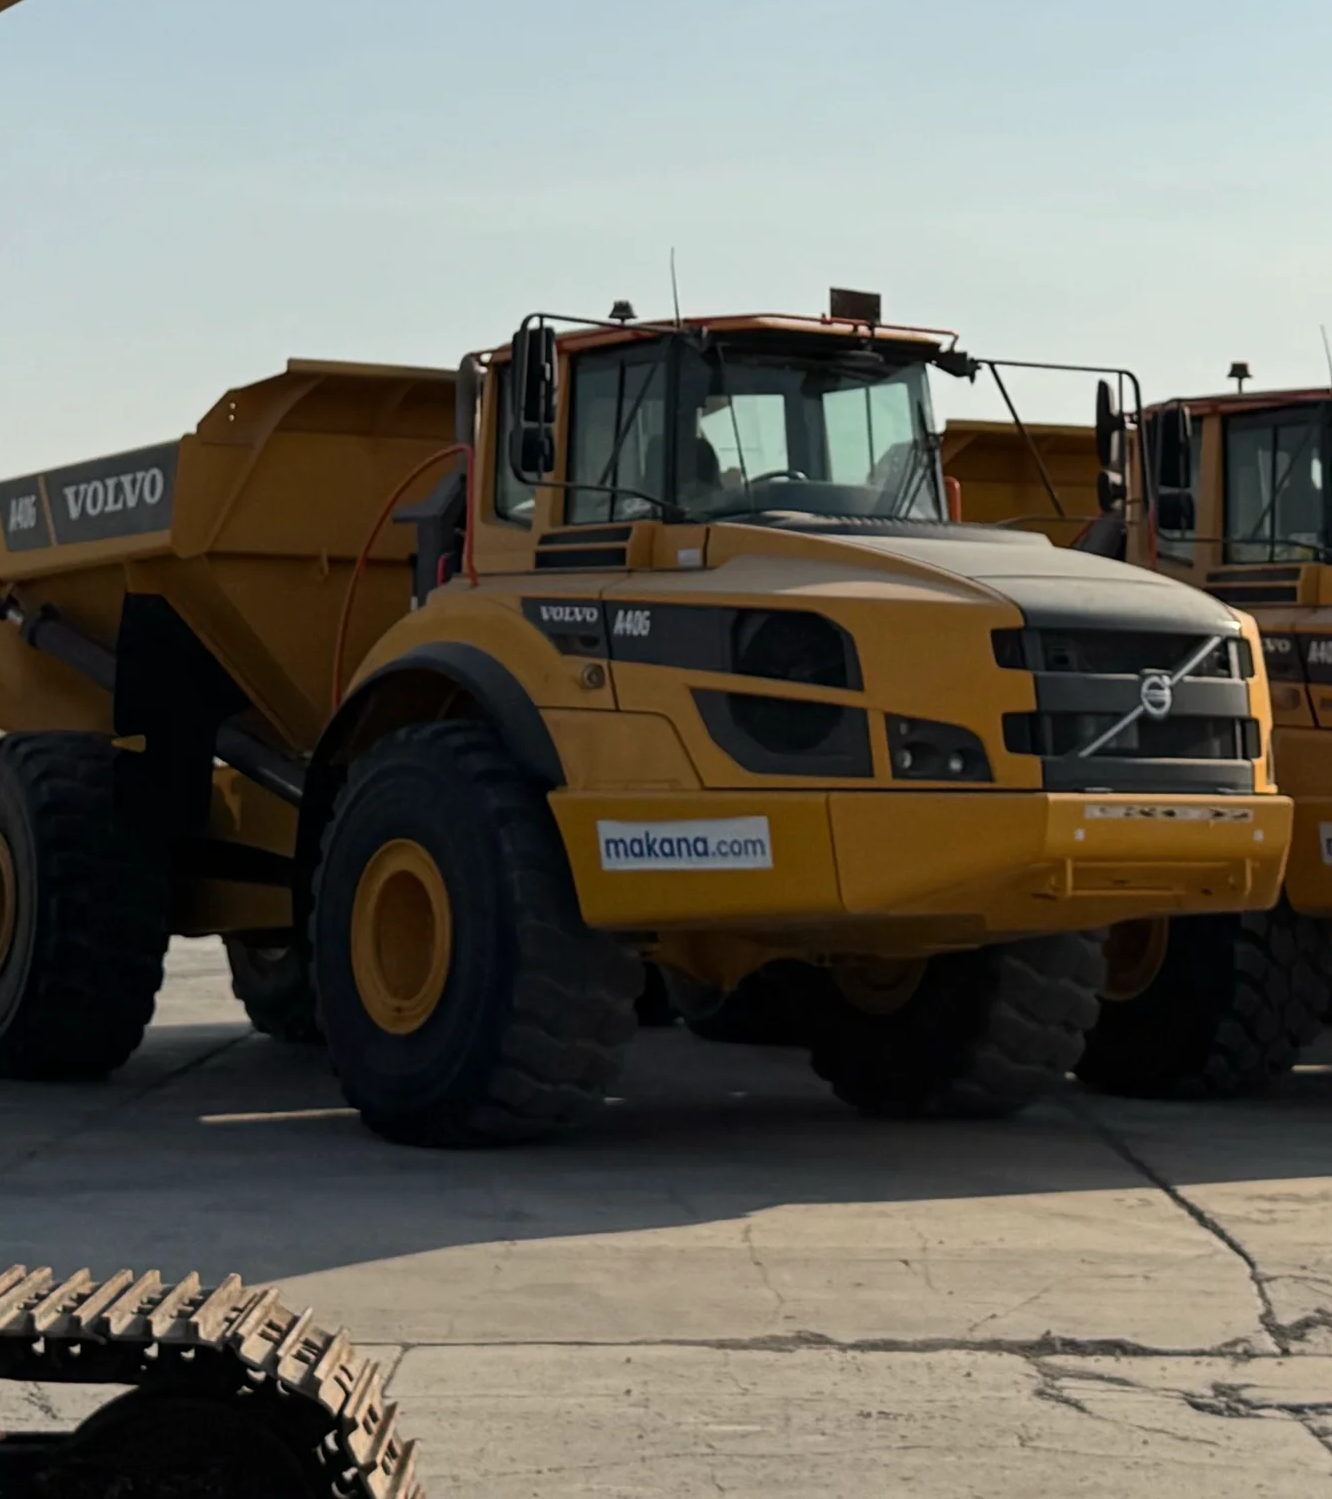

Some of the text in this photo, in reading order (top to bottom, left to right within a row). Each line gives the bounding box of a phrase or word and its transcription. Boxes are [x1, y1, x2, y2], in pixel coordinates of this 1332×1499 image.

[63, 466, 165, 521] VOLVO
[539, 605, 651, 636] VOLVO A40G
[604, 830, 766, 859] makana.com
